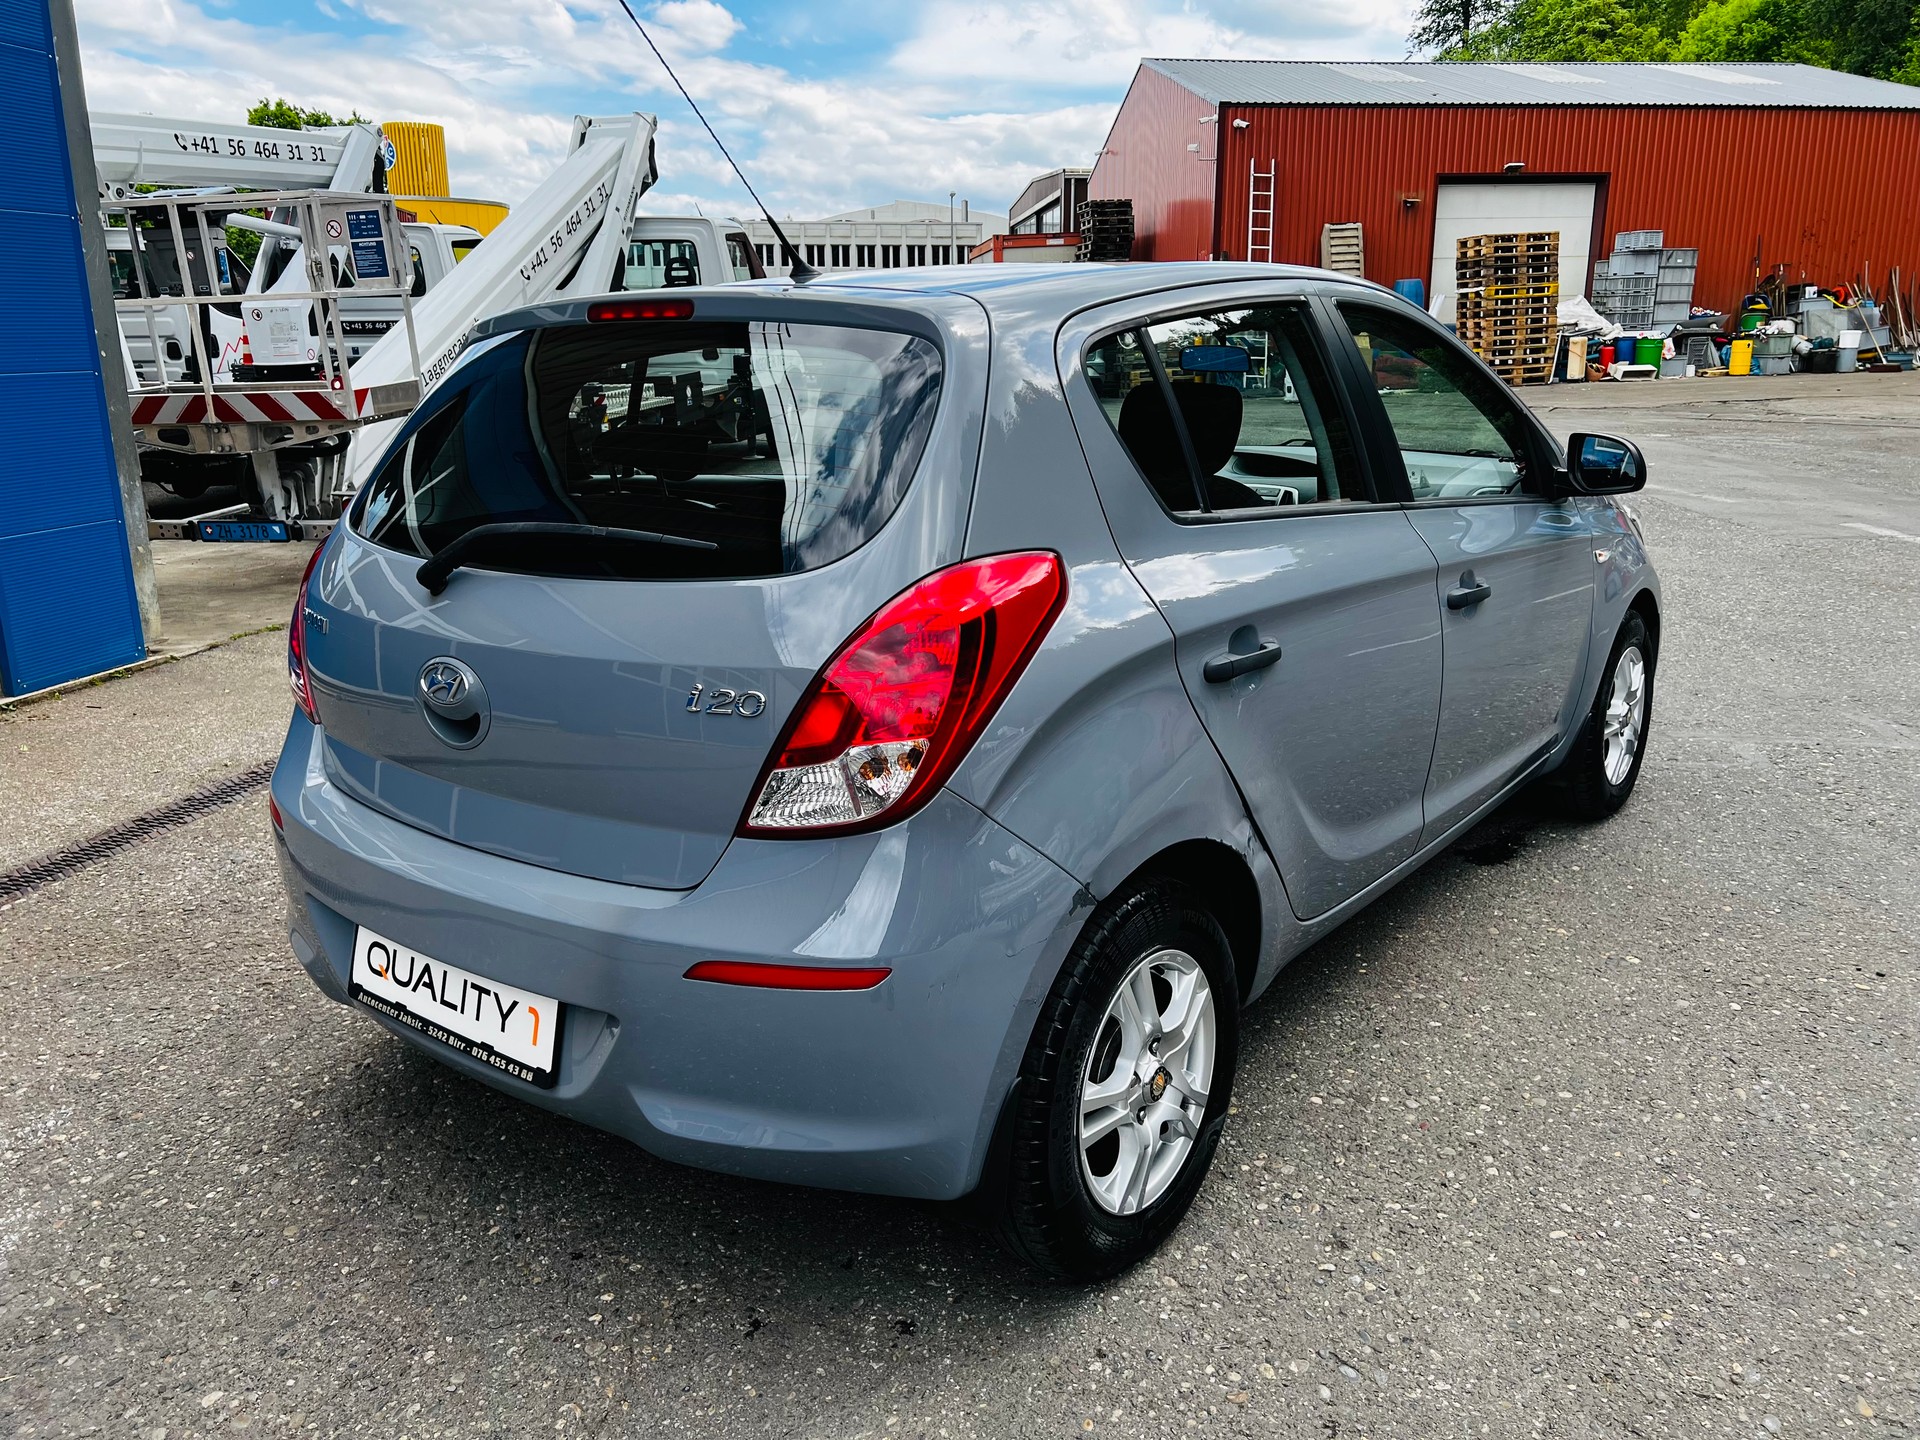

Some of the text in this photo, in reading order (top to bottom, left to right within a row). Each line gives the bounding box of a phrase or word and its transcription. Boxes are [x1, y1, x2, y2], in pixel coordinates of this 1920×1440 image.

[190, 136, 327, 162] +41 56 464 31 31
[530, 182, 609, 274] +41 56 464 31 31
[686, 683, 767, 718] i20
[358, 991, 399, 1018] Autocenter
[398, 1011, 423, 1030] Jaksic
[427, 1025, 448, 1043] 5242
[448, 1035, 466, 1051] Birr
[471, 1046, 489, 1062] 076
[488, 1055, 507, 1070] 455
[507, 1063, 520, 1076] 43
[367, 941, 540, 1046] QUALITY 1
